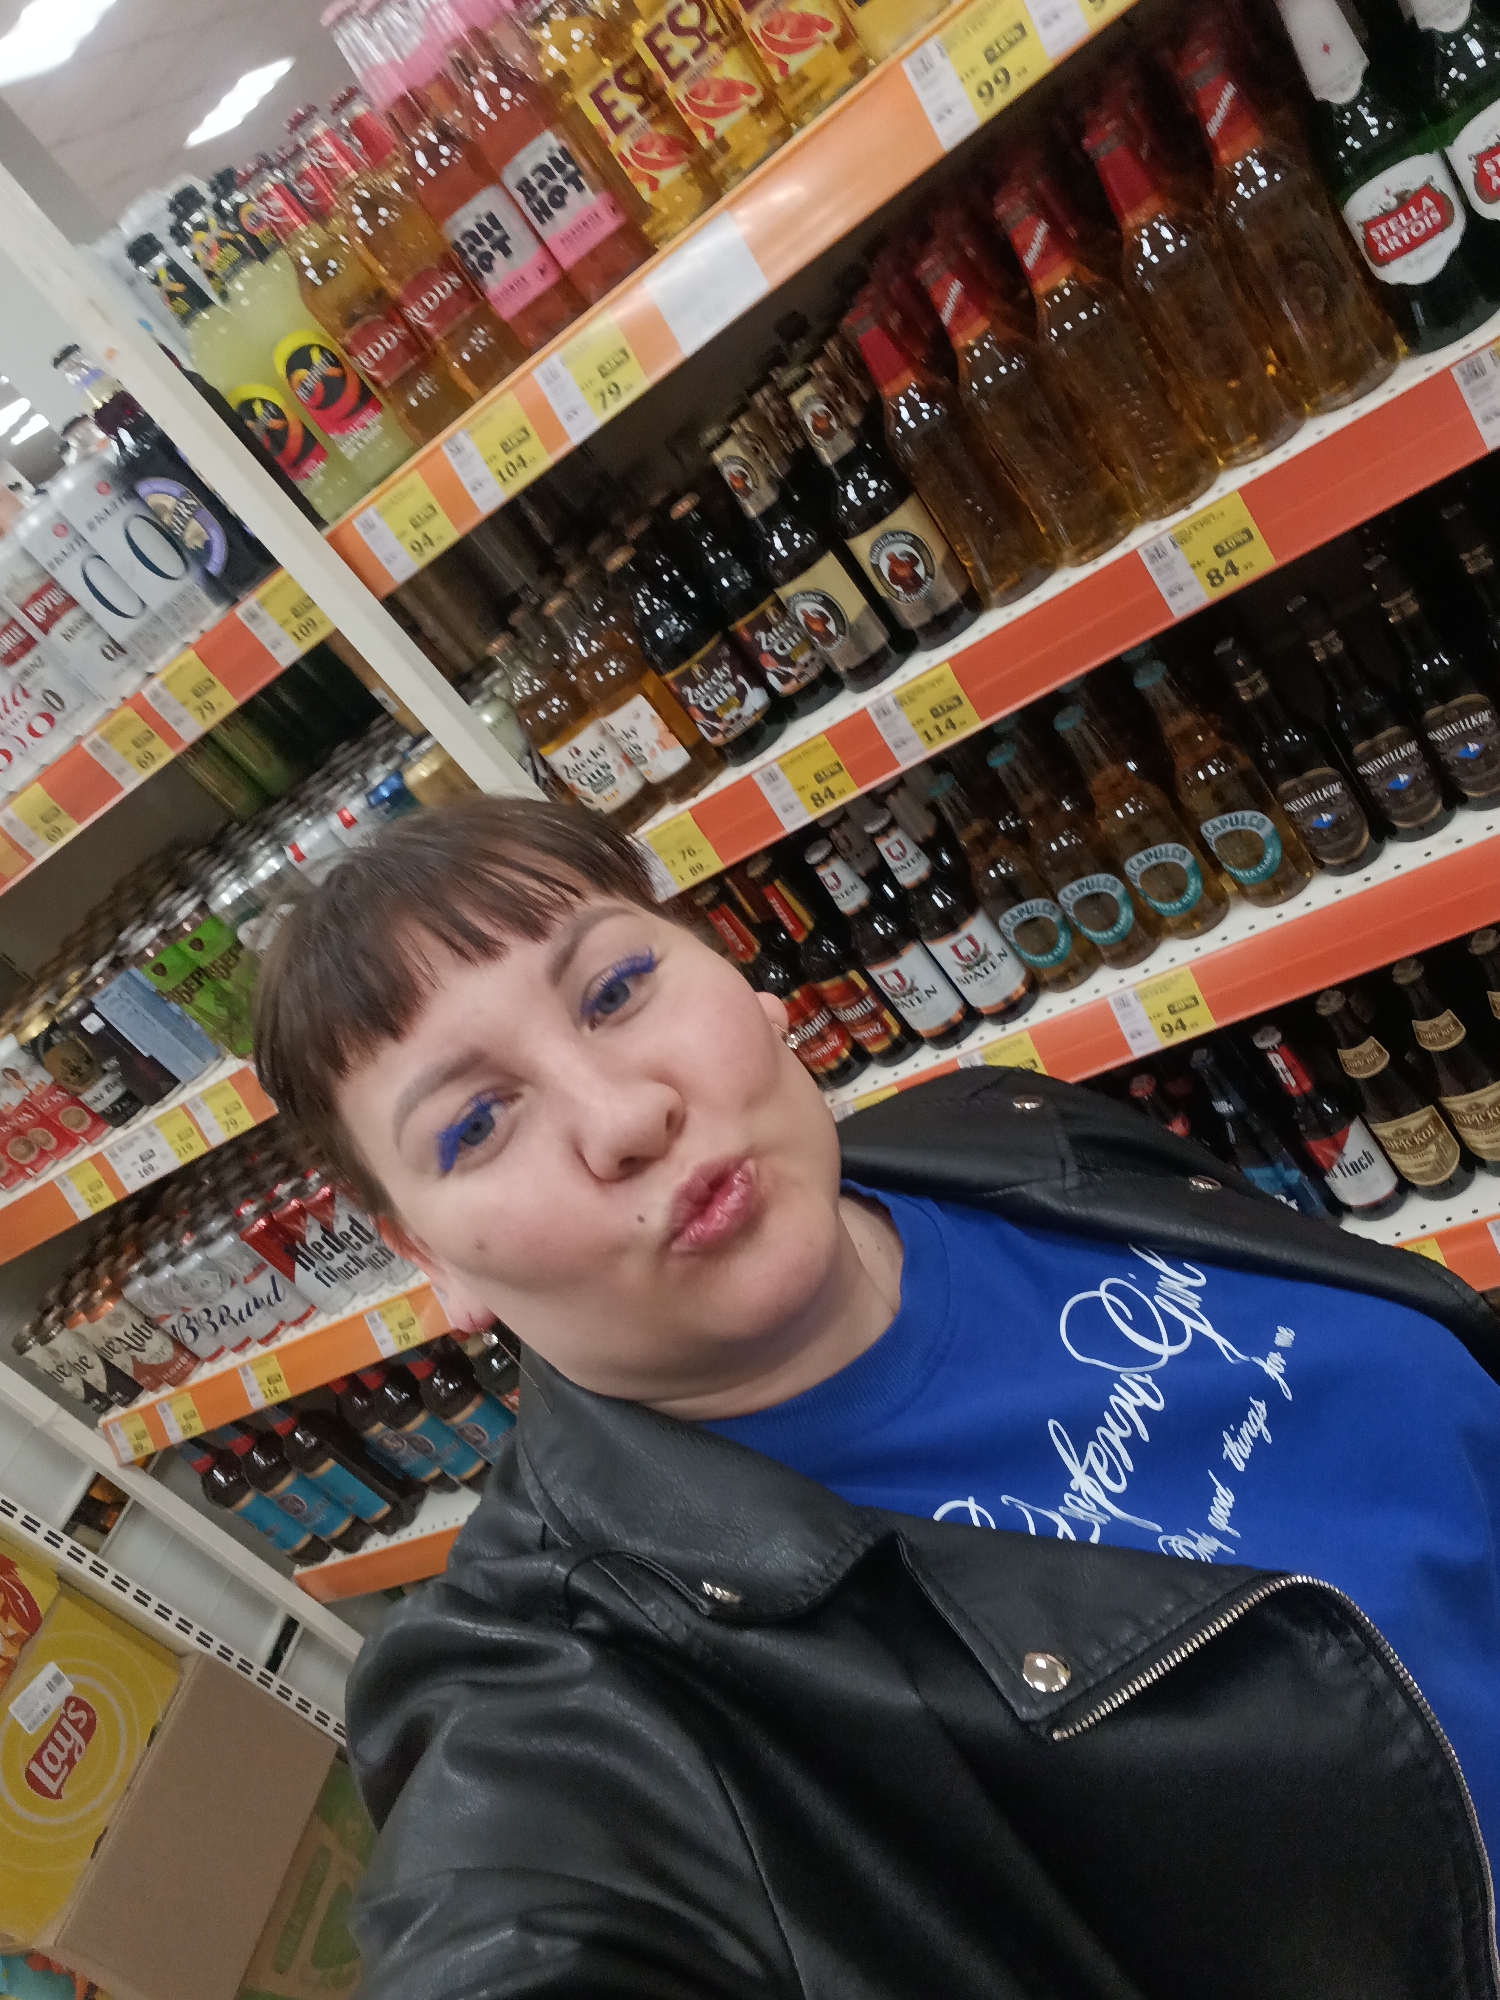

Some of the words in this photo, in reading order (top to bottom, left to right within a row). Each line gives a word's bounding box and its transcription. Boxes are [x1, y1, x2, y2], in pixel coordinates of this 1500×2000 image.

[1369, 195, 1436, 242] STELLA
[1377, 207, 1442, 256] ARTOIS
[495, 454, 530, 484] 104
[1204, 559, 1241, 591] 84
[920, 715, 958, 746] 114
[808, 784, 838, 809] 84
[1161, 1016, 1188, 1039] 94
[1274, 1325, 1296, 1348] me
[1251, 1351, 1293, 1402] for
[1222, 1397, 1272, 1473] things
[1208, 1469, 1241, 1538] good
